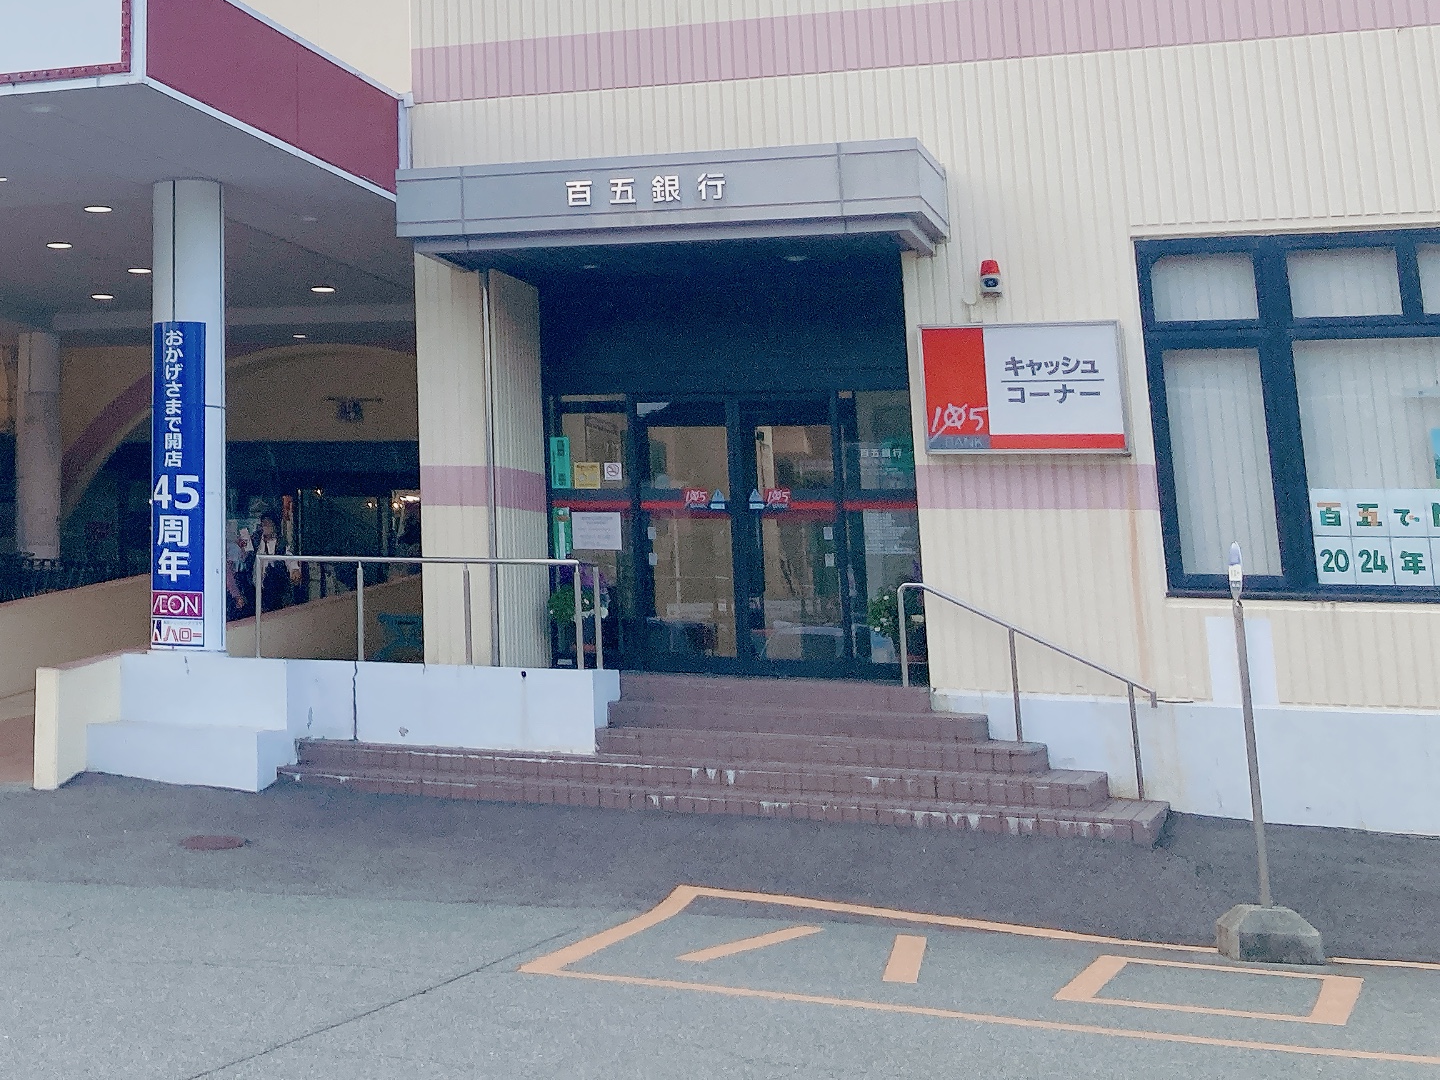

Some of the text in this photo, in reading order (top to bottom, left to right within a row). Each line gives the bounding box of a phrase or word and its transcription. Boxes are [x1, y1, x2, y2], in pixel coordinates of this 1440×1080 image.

[565, 172, 728, 207] 百五銀行
[1004, 356, 1100, 377] キャッシュ
[1006, 383, 1101, 404] コーナー
[1319, 548, 1427, 575] 2024年
